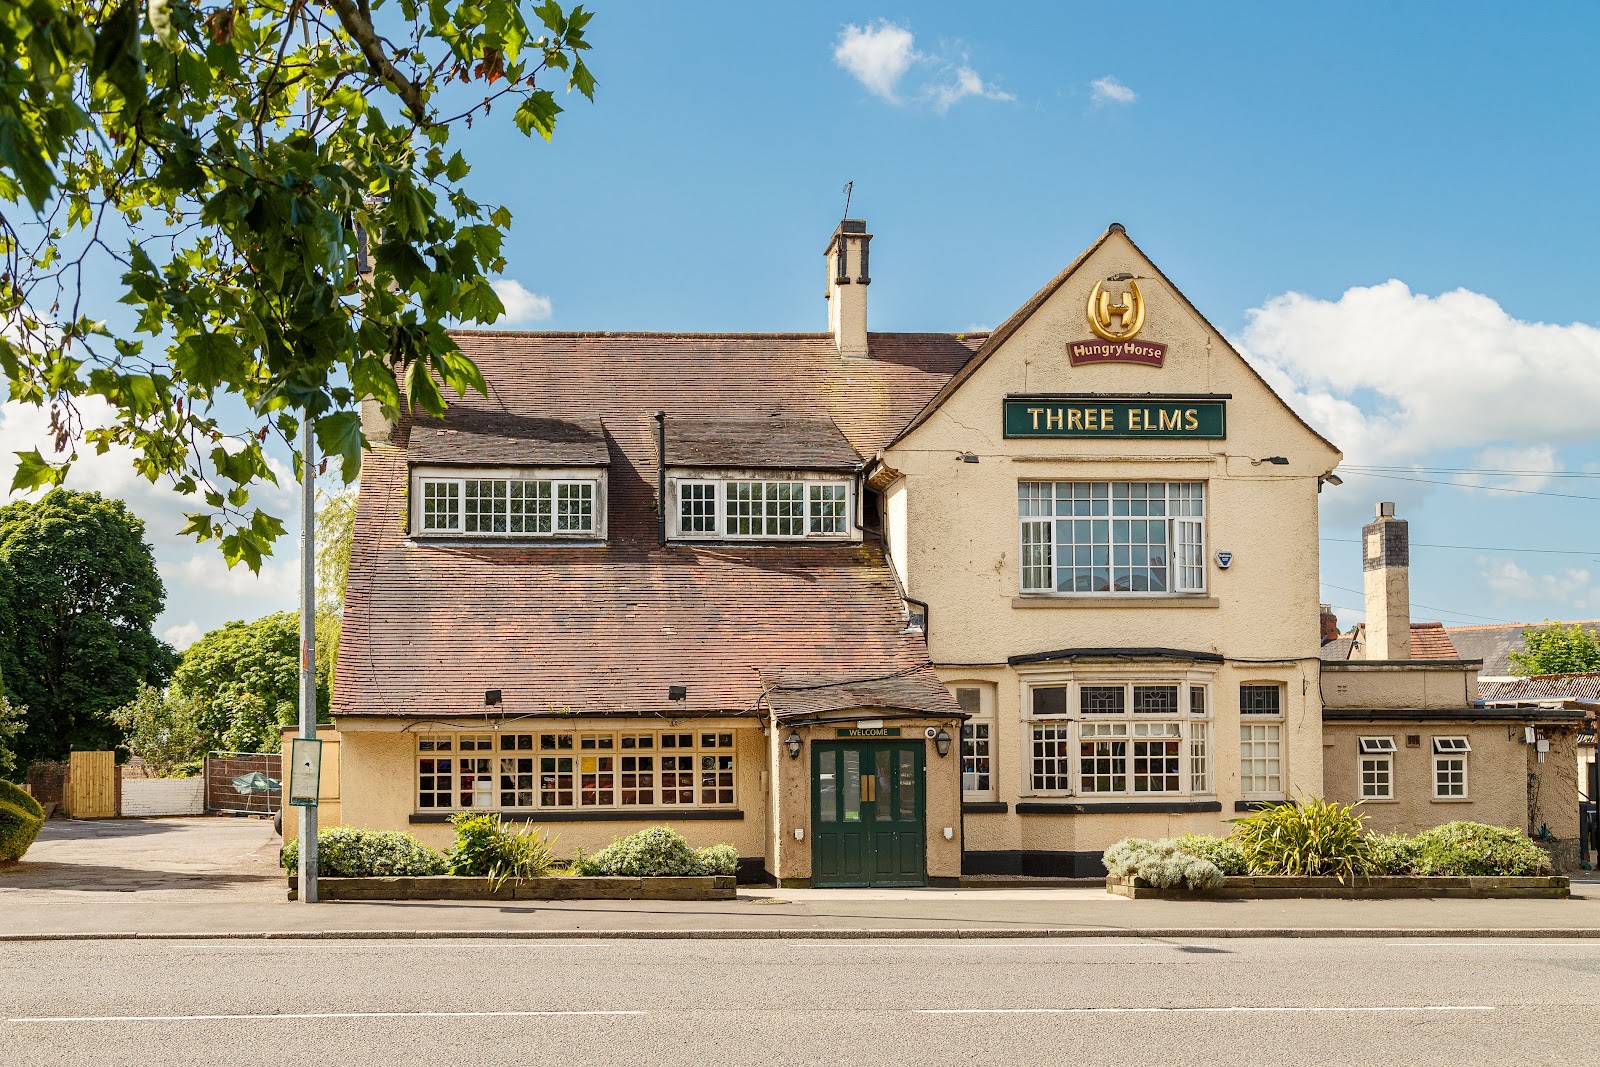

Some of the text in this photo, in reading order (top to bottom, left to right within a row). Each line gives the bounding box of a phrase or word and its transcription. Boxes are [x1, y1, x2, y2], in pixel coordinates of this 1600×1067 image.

[1027, 408, 1199, 431] THREE ELMS
[849, 728, 888, 736] WELCOME
